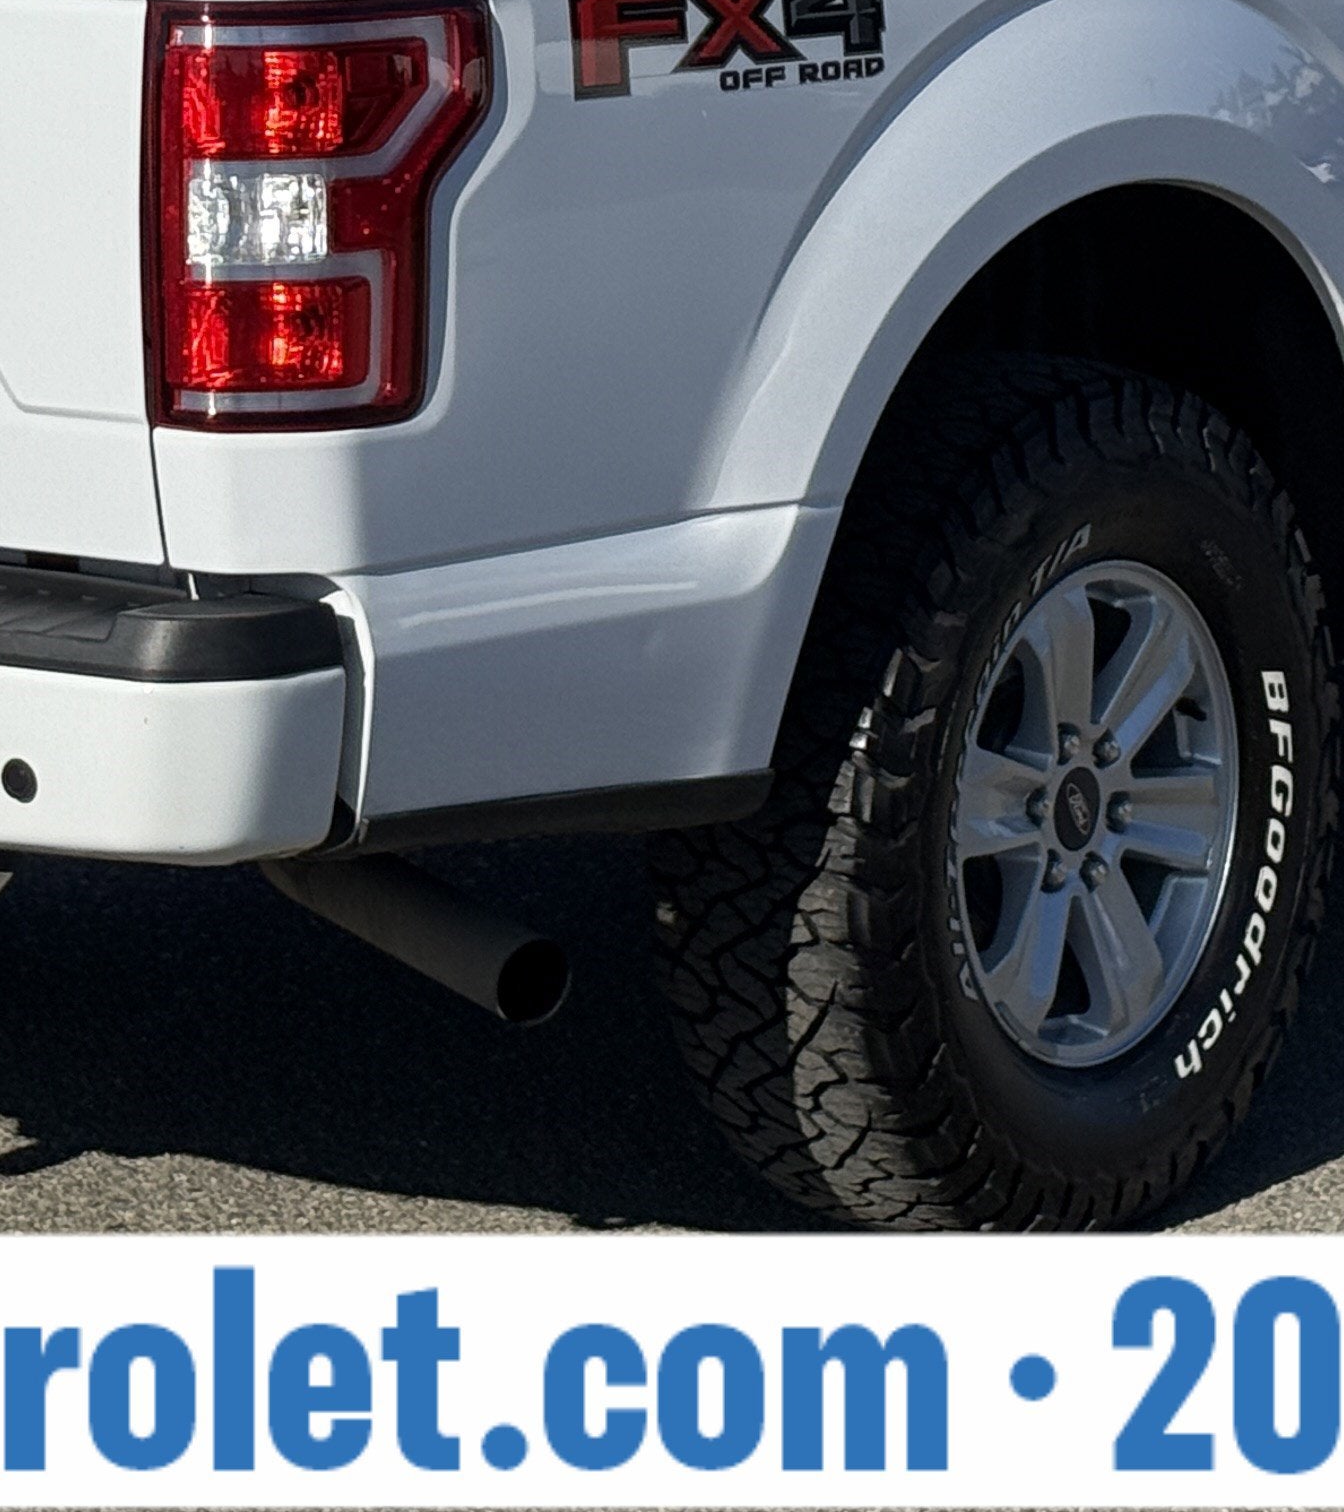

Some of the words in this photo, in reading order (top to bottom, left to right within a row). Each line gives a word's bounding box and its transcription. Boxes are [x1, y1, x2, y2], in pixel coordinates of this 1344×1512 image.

[719, 66, 786, 93] OFF
[798, 56, 886, 85] ROAD
[1174, 670, 1295, 1079] BFGoodrich
